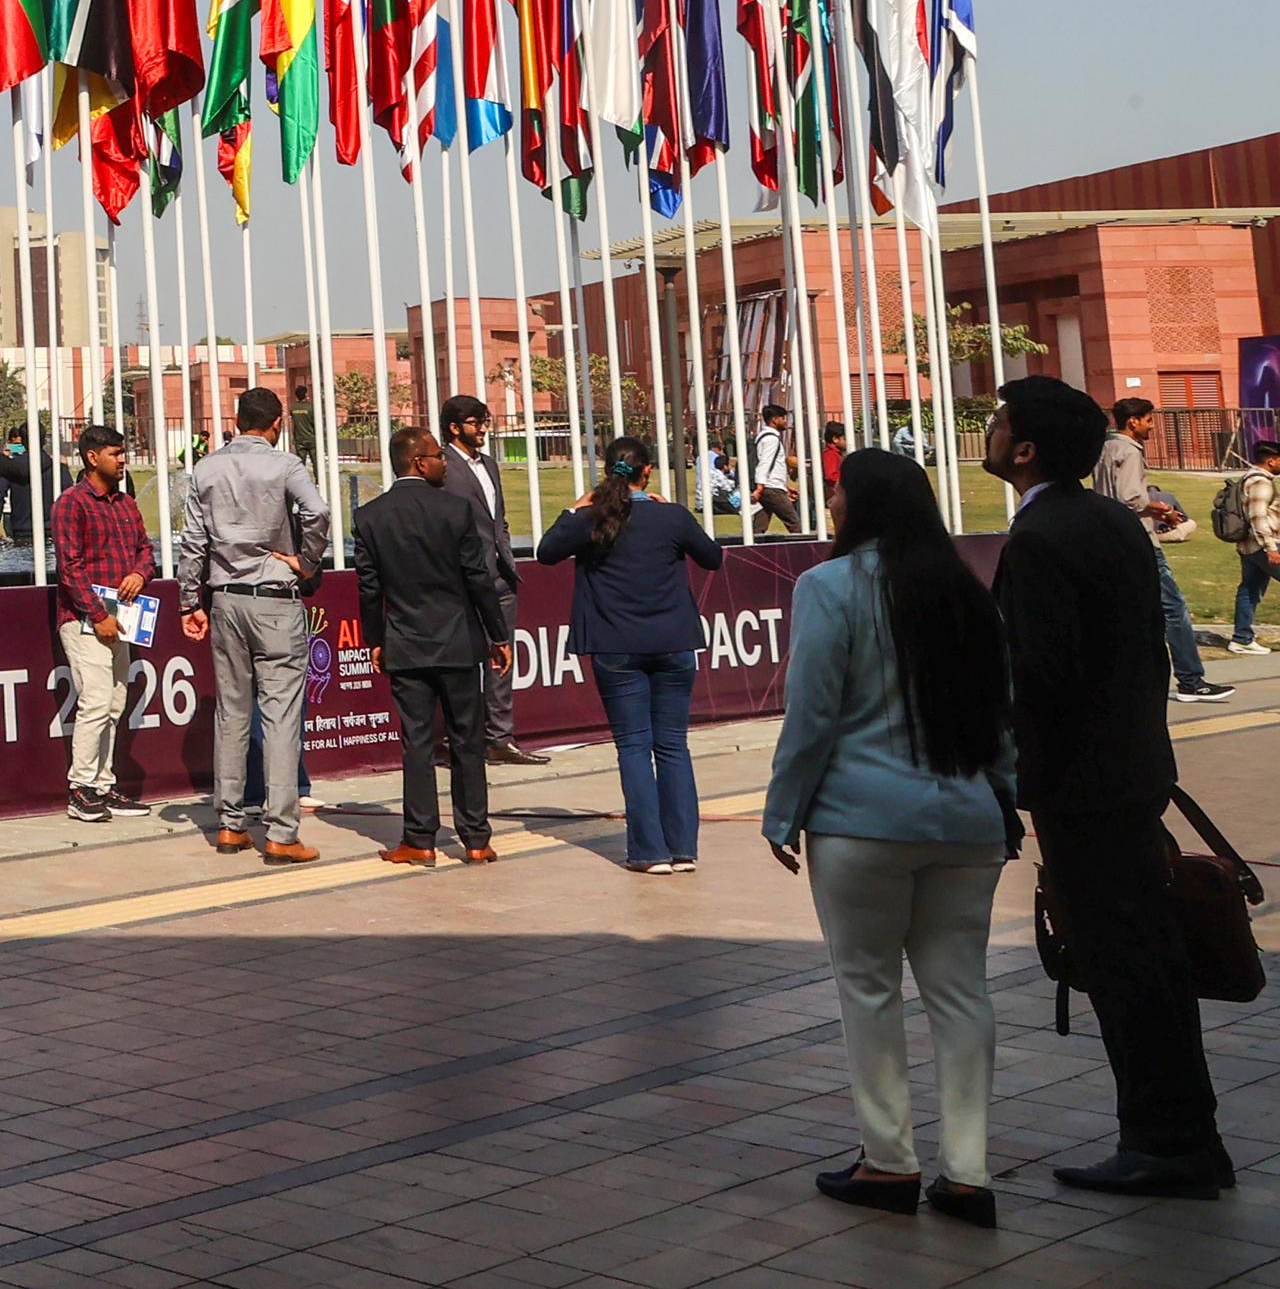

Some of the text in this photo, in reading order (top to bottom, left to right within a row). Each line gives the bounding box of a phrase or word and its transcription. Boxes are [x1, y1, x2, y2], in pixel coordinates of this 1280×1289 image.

[338, 619, 359, 648] AI
[338, 648, 371, 663] IMPACT
[511, 608, 783, 690] DIA ACT
[46, 655, 197, 738] 226
[312, 738, 326, 750] FOR
[326, 737, 338, 748] ALL
[343, 733, 378, 746] HAPPINESS
[378, 731, 388, 742] OF
[388, 730, 400, 741] ALL
